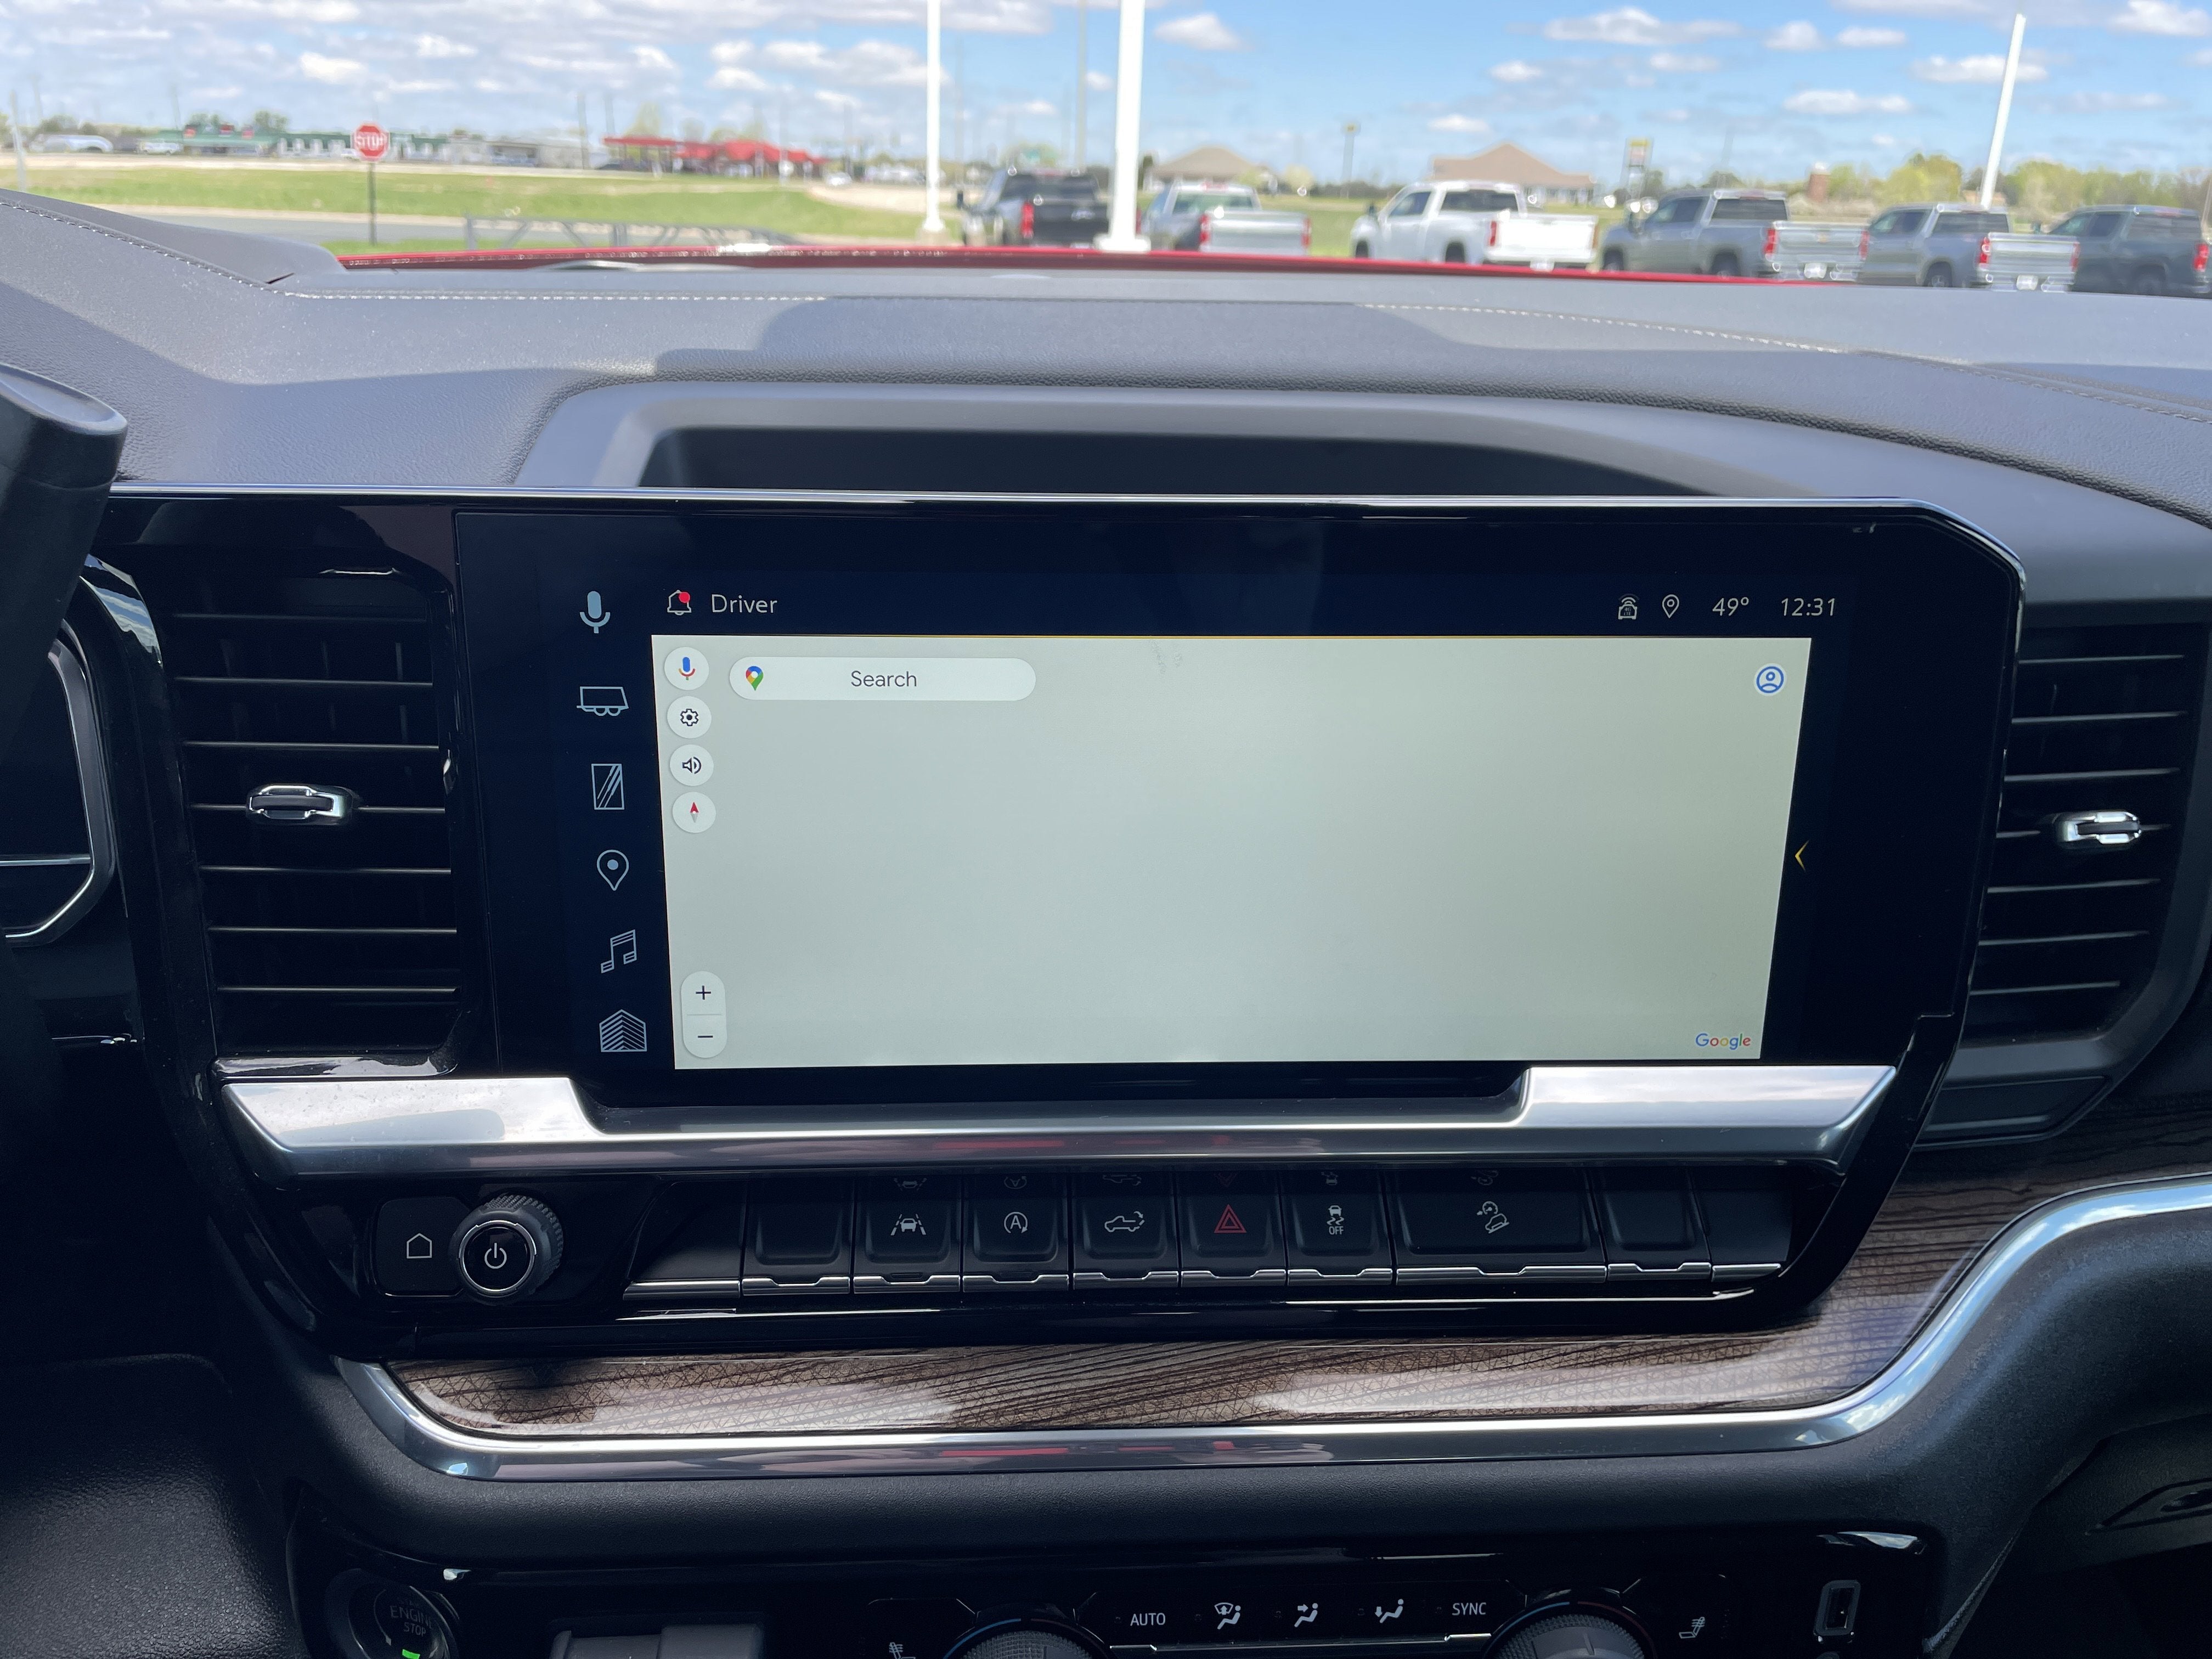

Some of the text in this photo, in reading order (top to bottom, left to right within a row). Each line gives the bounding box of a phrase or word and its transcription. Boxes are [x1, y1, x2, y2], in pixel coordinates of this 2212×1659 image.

[355, 134, 383, 148] STOP
[712, 594, 778, 614] Driver
[1712, 597, 1836, 617] 49° 12:31
[851, 670, 918, 688] Search
[1695, 1033, 1752, 1051] Google
[1329, 1226, 1344, 1235] OFF
[390, 1605, 433, 1629] ENGINE
[1452, 1602, 1487, 1616] SYNC
[1130, 1613, 1166, 1627] AUTO
[403, 1622, 426, 1637] STOP
